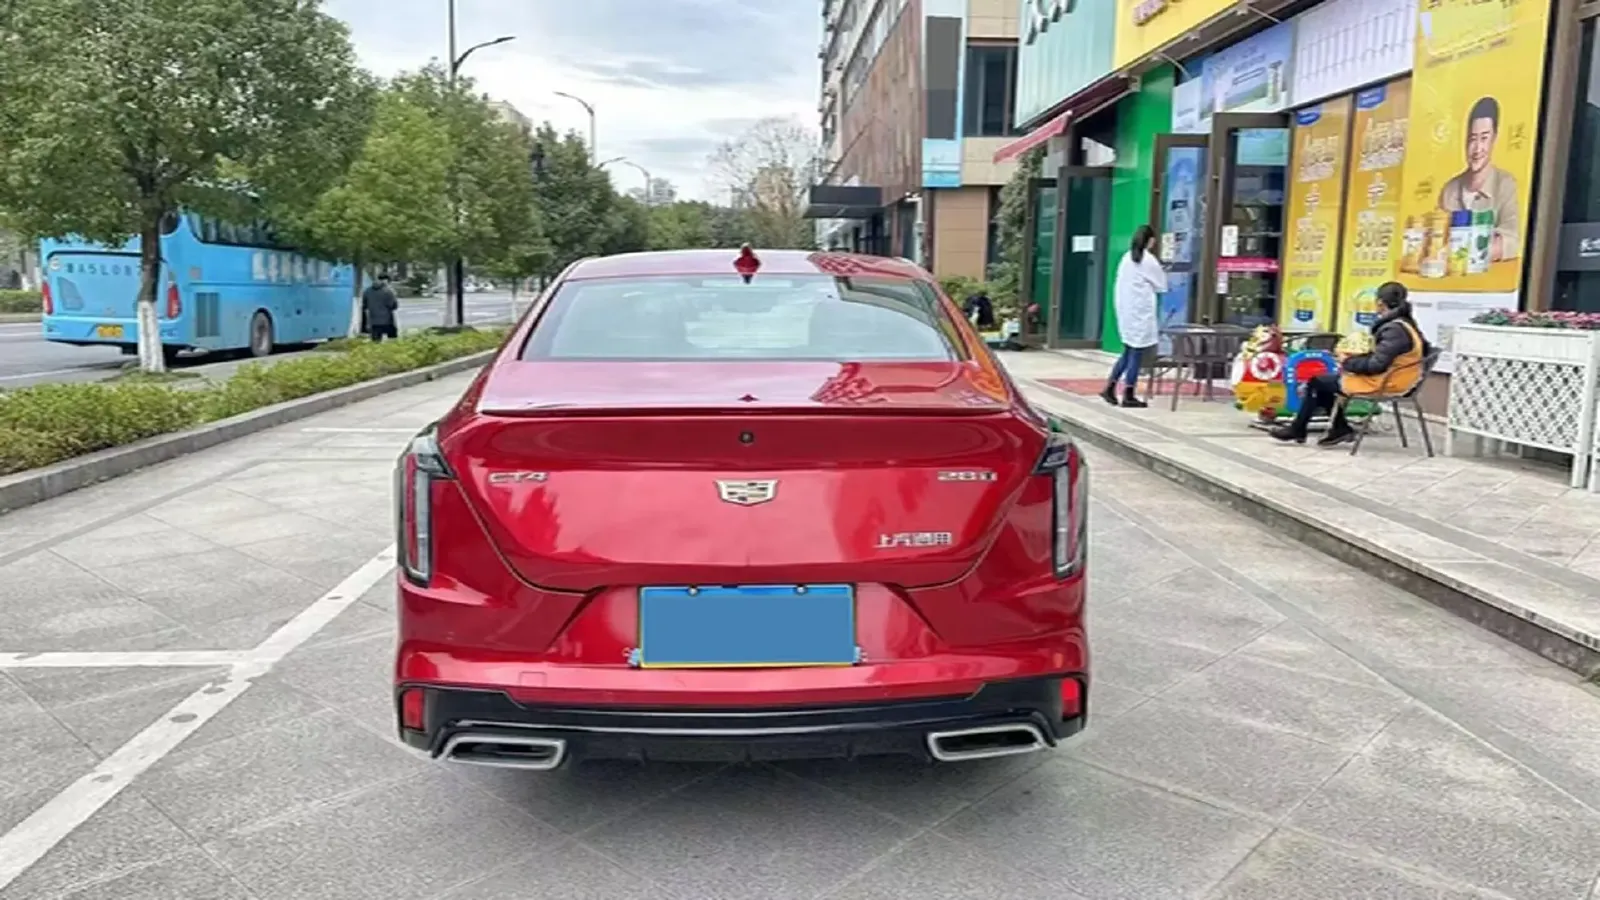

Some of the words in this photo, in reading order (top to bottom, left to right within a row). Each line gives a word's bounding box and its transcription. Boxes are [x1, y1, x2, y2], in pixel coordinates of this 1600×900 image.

[488, 471, 549, 483] CT4
[873, 531, 953, 549] 上汽通用
